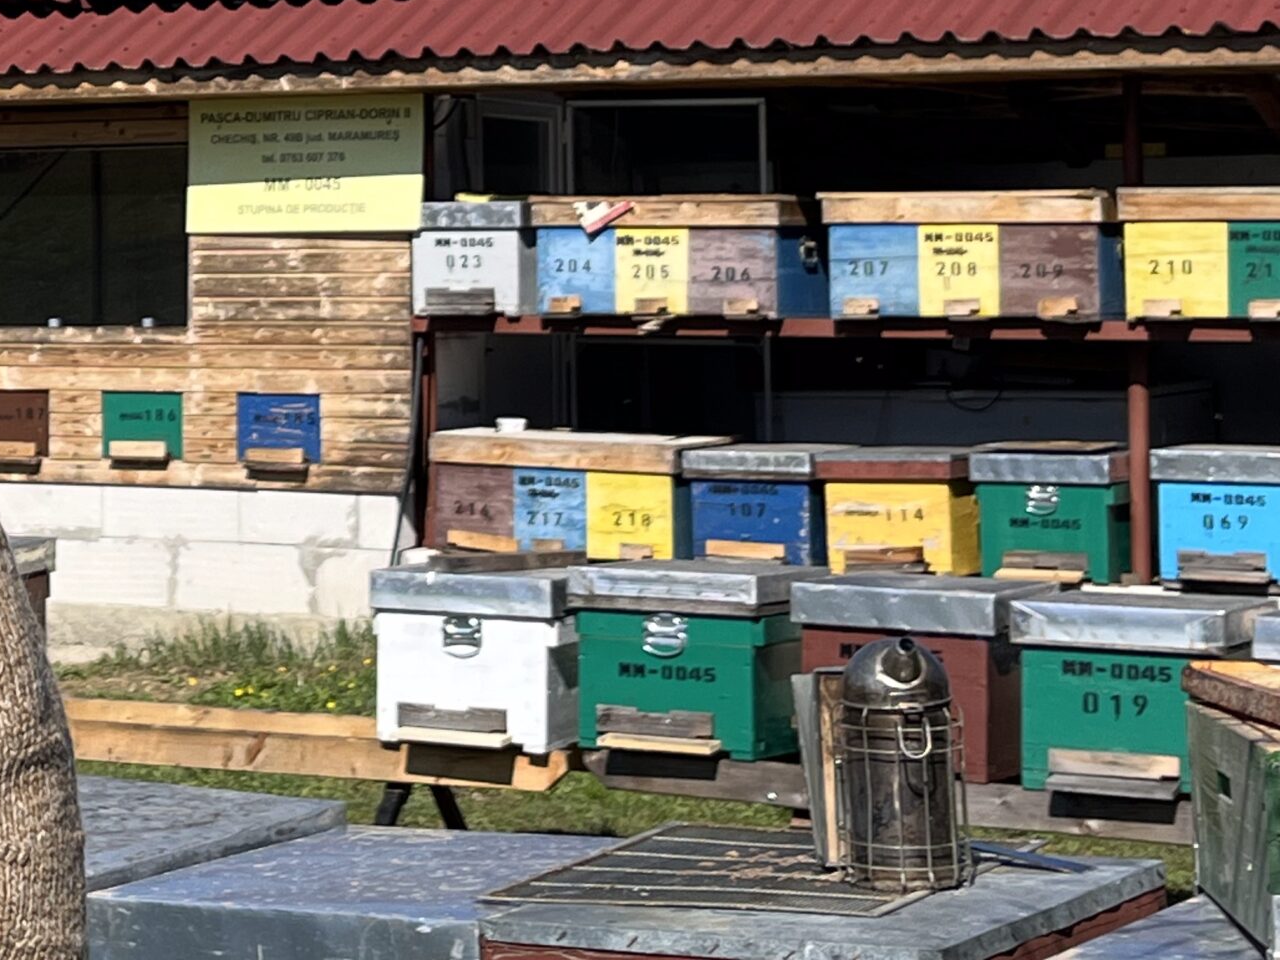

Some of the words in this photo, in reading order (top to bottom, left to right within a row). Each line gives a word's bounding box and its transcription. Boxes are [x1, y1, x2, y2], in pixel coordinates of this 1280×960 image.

[305, 176, 341, 191] 0045
[286, 203, 300, 214] DE
[553, 258, 592, 273] 204
[632, 263, 670, 280] 205
[711, 265, 751, 282] 206
[848, 260, 889, 278] 207
[935, 261, 978, 276] 208
[1149, 259, 1193, 276] 210
[526, 511, 563, 526] 217
[618, 661, 717, 683] MM-0045
[1062, 659, 1173, 683] MM-0045
[1082, 691, 1149, 720] 019
